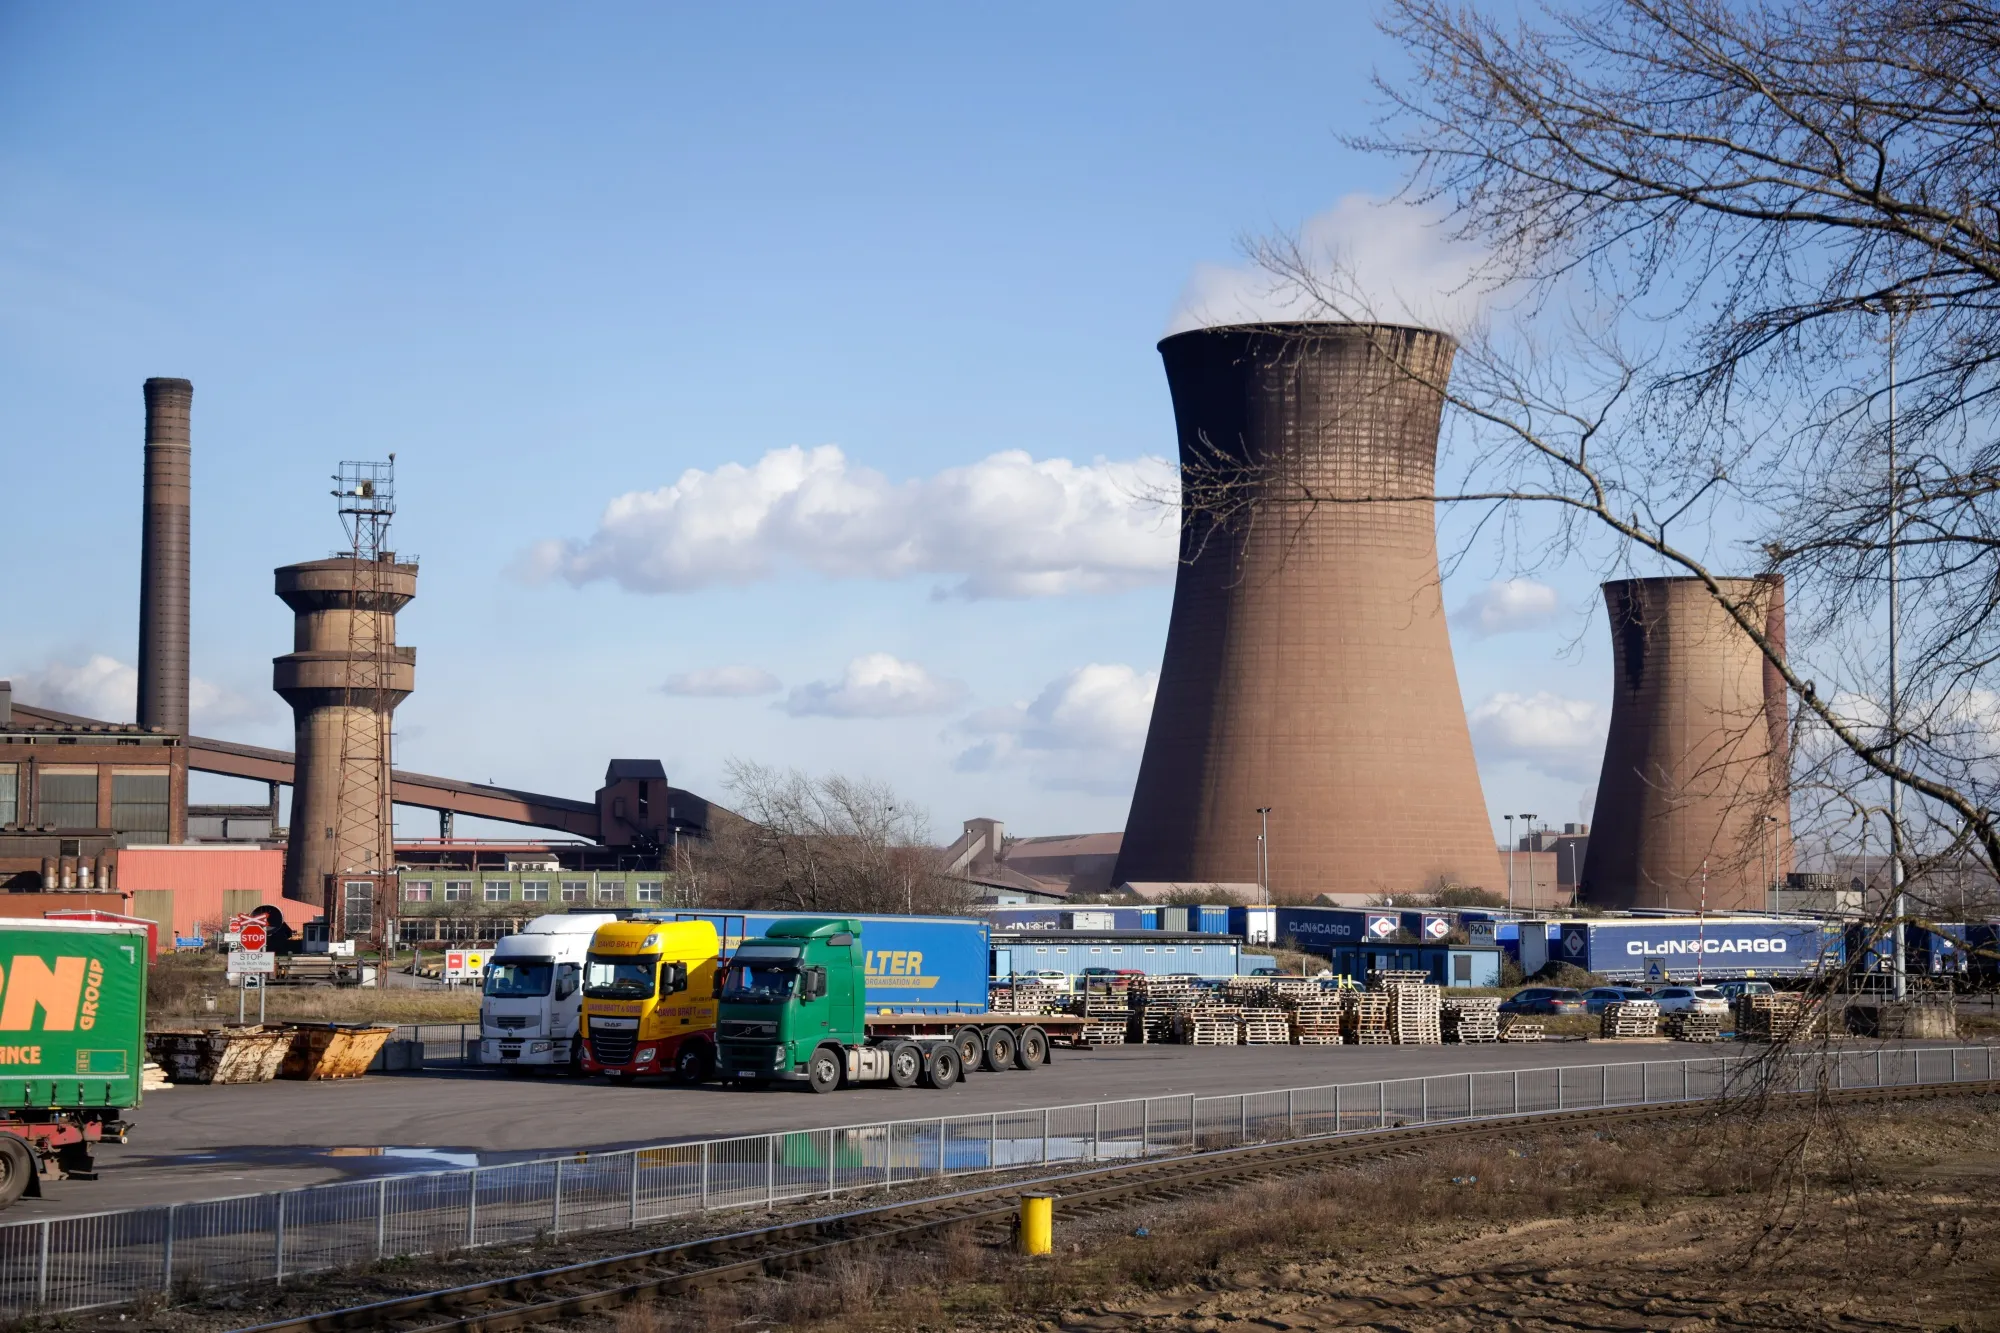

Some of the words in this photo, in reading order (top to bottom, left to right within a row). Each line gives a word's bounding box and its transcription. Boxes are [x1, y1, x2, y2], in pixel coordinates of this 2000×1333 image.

[1289, 921, 1312, 933] CLdN
[1317, 923, 1351, 936] CARGO
[1378, 921, 1388, 934] C
[1434, 922, 1444, 934] C
[241, 934, 265, 943] STOP
[597, 940, 615, 948] DAVID
[616, 940, 639, 949] BRATT
[1571, 936, 1578, 950] C
[1626, 939, 1686, 955] CLdN
[1703, 938, 1787, 953] CARGO
[240, 953, 264, 961] STOP
[0, 955, 87, 1031] N
[80, 958, 104, 1031] GROUP
[677, 1006, 697, 1017] BRATT
